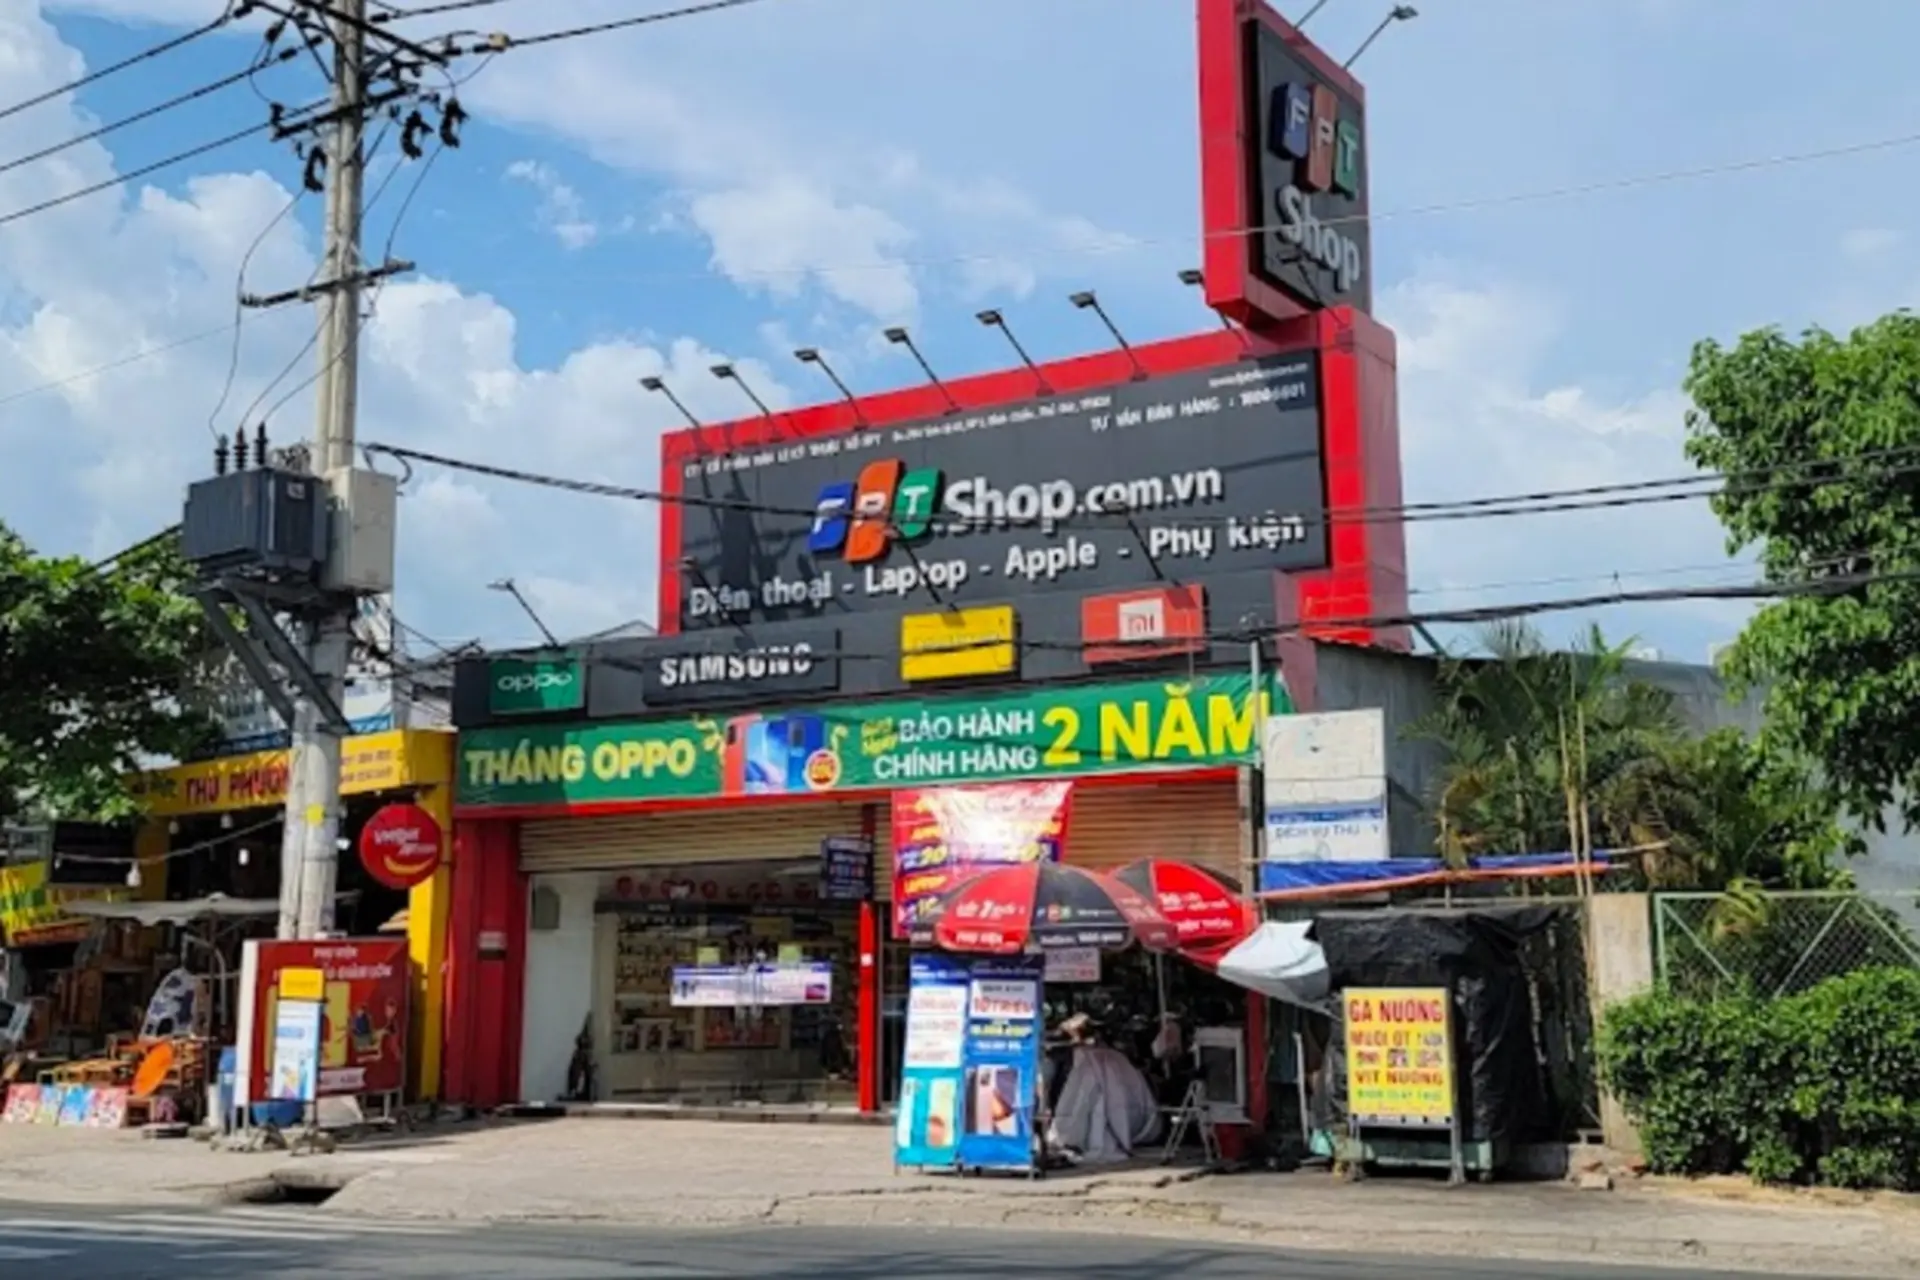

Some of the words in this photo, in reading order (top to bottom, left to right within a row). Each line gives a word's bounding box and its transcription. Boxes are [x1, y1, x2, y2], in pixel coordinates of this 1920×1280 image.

[1284, 92, 1358, 178] FPT
[1278, 184, 1361, 290] Shop
[811, 474, 934, 545] FPT
[762, 569, 833, 609] thoại
[864, 556, 968, 597] Laptop
[1004, 535, 1097, 580] Apple
[1149, 521, 1213, 559] Phụ
[1227, 508, 1306, 549] kiện
[465, 737, 586, 787] THÁNG
[592, 737, 697, 781] OPPO
[873, 746, 956, 779] CHÍNH
[960, 743, 1039, 774] HÃNG
[899, 710, 953, 743] BẢO
[958, 706, 1036, 739] HÀNH
[1042, 705, 1082, 766] 2
[1099, 682, 1270, 763] NĂM
